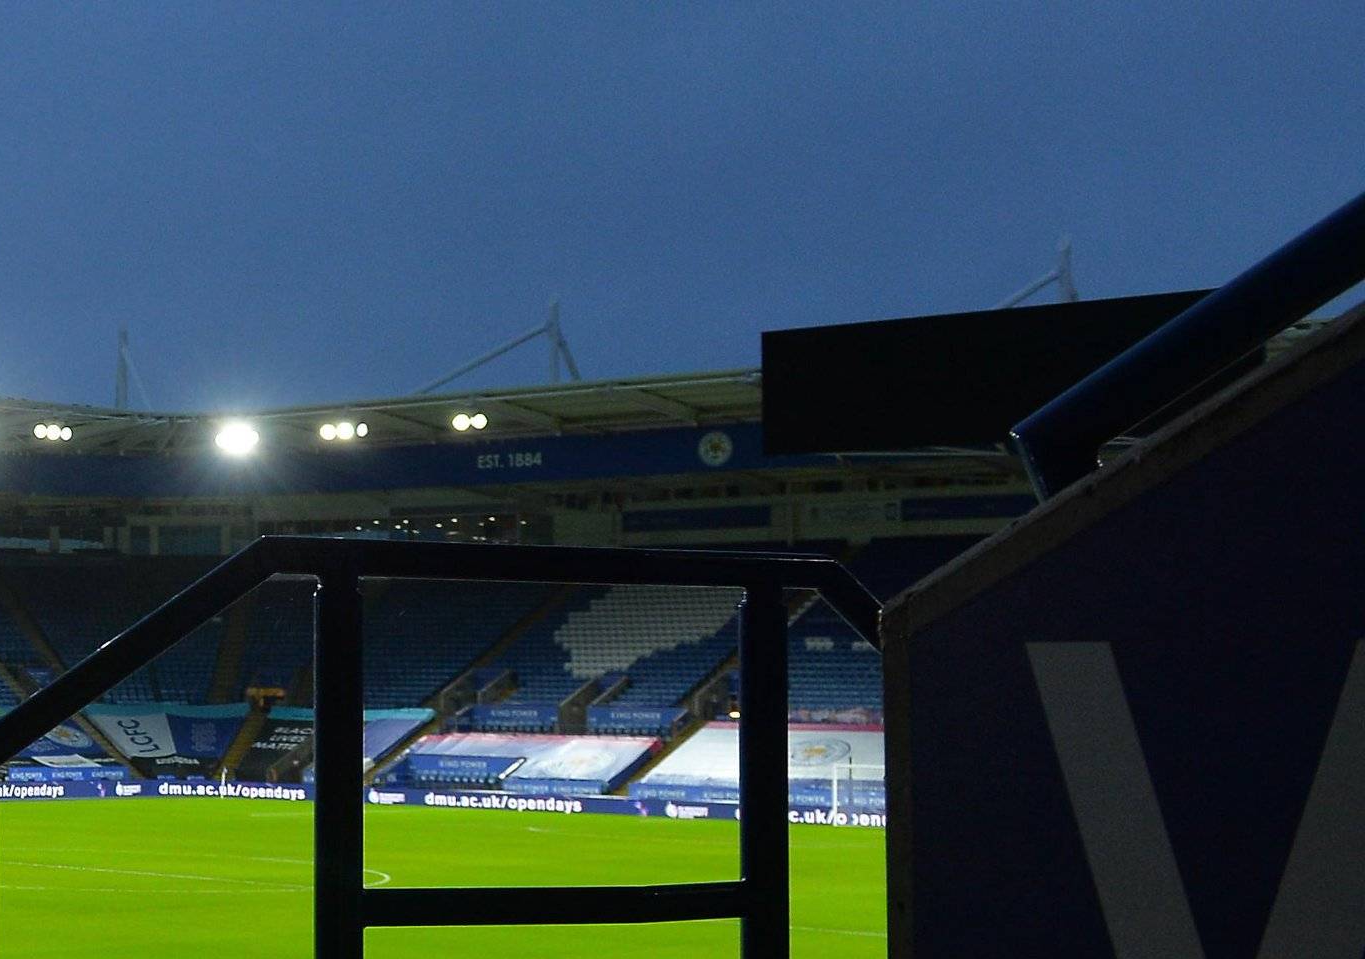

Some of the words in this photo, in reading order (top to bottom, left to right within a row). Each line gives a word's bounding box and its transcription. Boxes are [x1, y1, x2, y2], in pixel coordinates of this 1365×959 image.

[509, 452, 542, 467] 1884
[117, 719, 160, 754] LCFC
[424, 791, 583, 814] dmu.ac.uk/opendays
